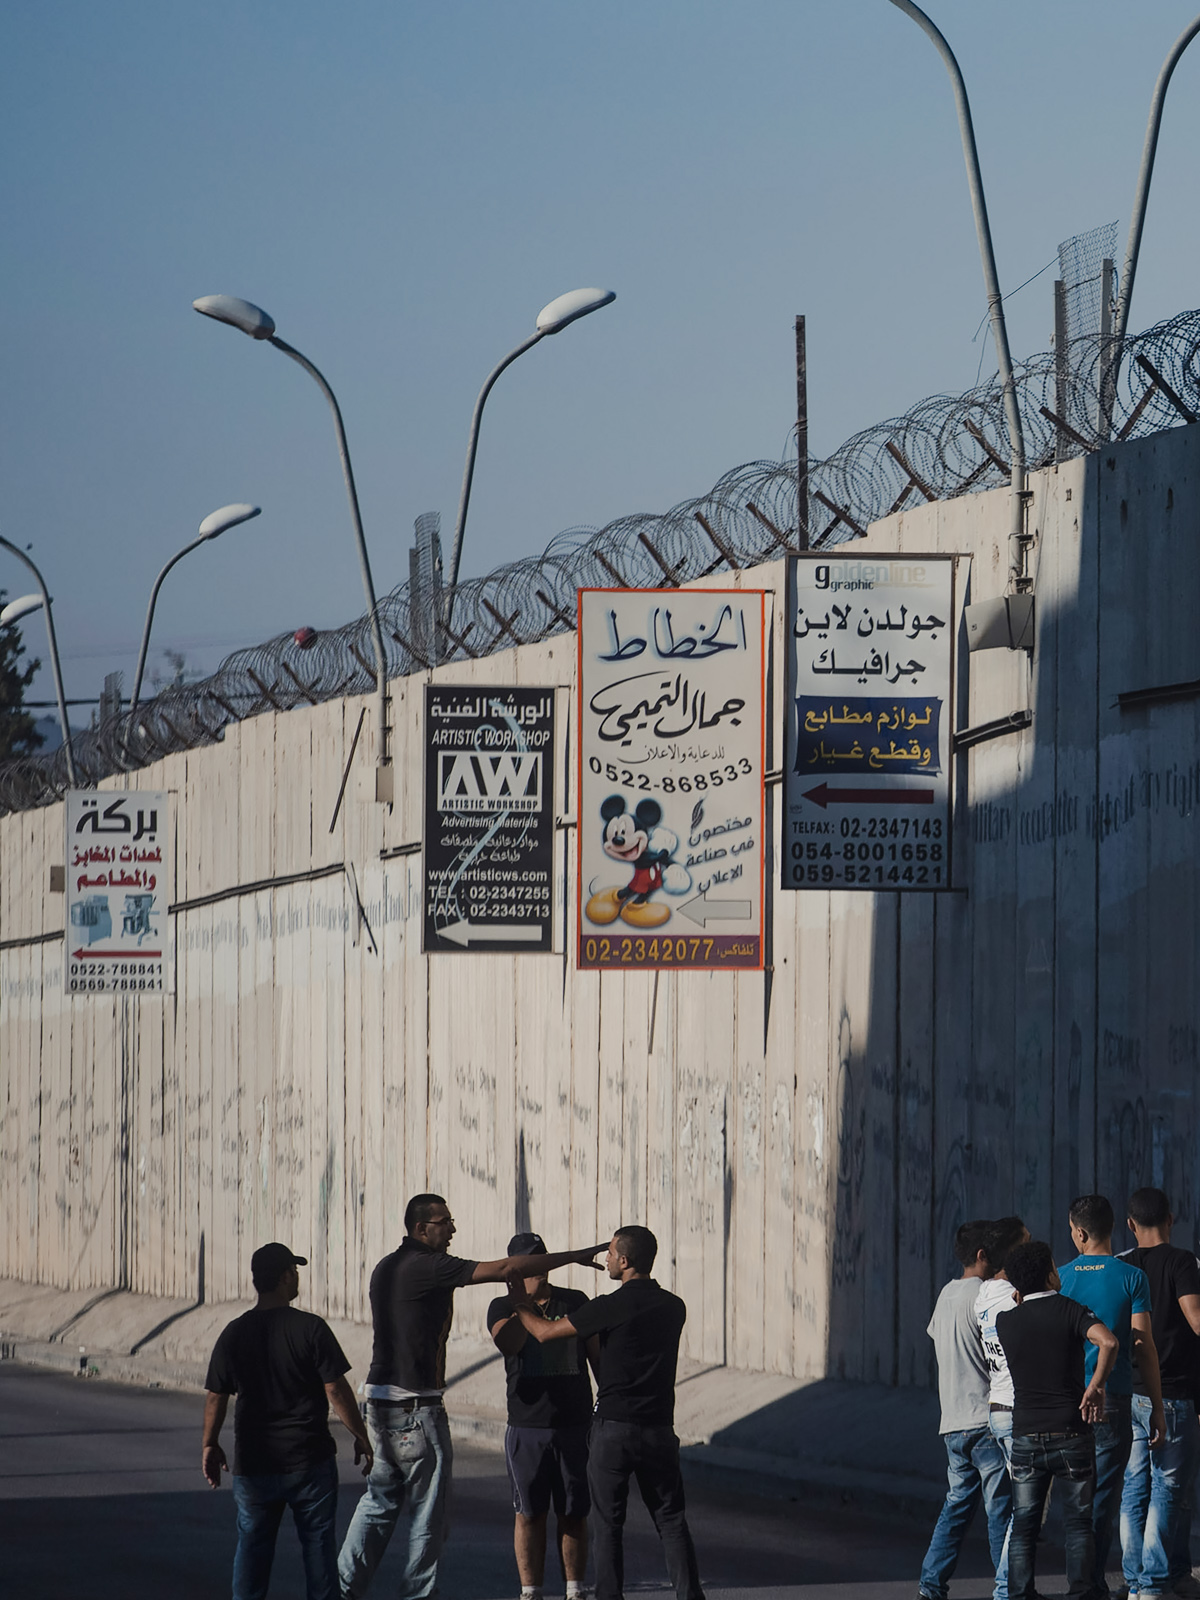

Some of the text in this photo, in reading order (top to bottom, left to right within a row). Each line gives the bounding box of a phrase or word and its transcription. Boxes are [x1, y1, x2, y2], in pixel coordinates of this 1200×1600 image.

[830, 579, 874, 592] graphic
[598, 604, 747, 662] الخطاط
[793, 603, 946, 640] جولدن لاين
[811, 648, 926, 684] جرافيك
[431, 694, 551, 725] الورشة الفنية
[589, 670, 746, 747] جمال التميمي
[804, 705, 932, 734] لوازم مطابع
[431, 728, 551, 747] ARTISTIC WORKSHOP
[808, 739, 931, 768] وقطع غيار
[589, 756, 753, 793] 0522-868533
[442, 799, 538, 811] ARTISTIC WORKSHOP
[75, 798, 158, 842] بركة
[441, 816, 494, 829] Advertising
[688, 816, 753, 847] مختصون
[840, 818, 942, 838] 02-2347143
[686, 836, 755, 867] في صناعة
[791, 842, 943, 861] 054-8001658
[76, 868, 158, 893] والمطاعم
[792, 864, 942, 883] 059-5214421
[469, 886, 550, 900] 02-2347255
[470, 904, 550, 917] 02-2343713
[586, 938, 714, 962] 02-2342077
[70, 963, 163, 977] 0522-788841
[70, 978, 163, 991] 0569-788841
[1074, 1264, 1106, 1272] CLICKER
